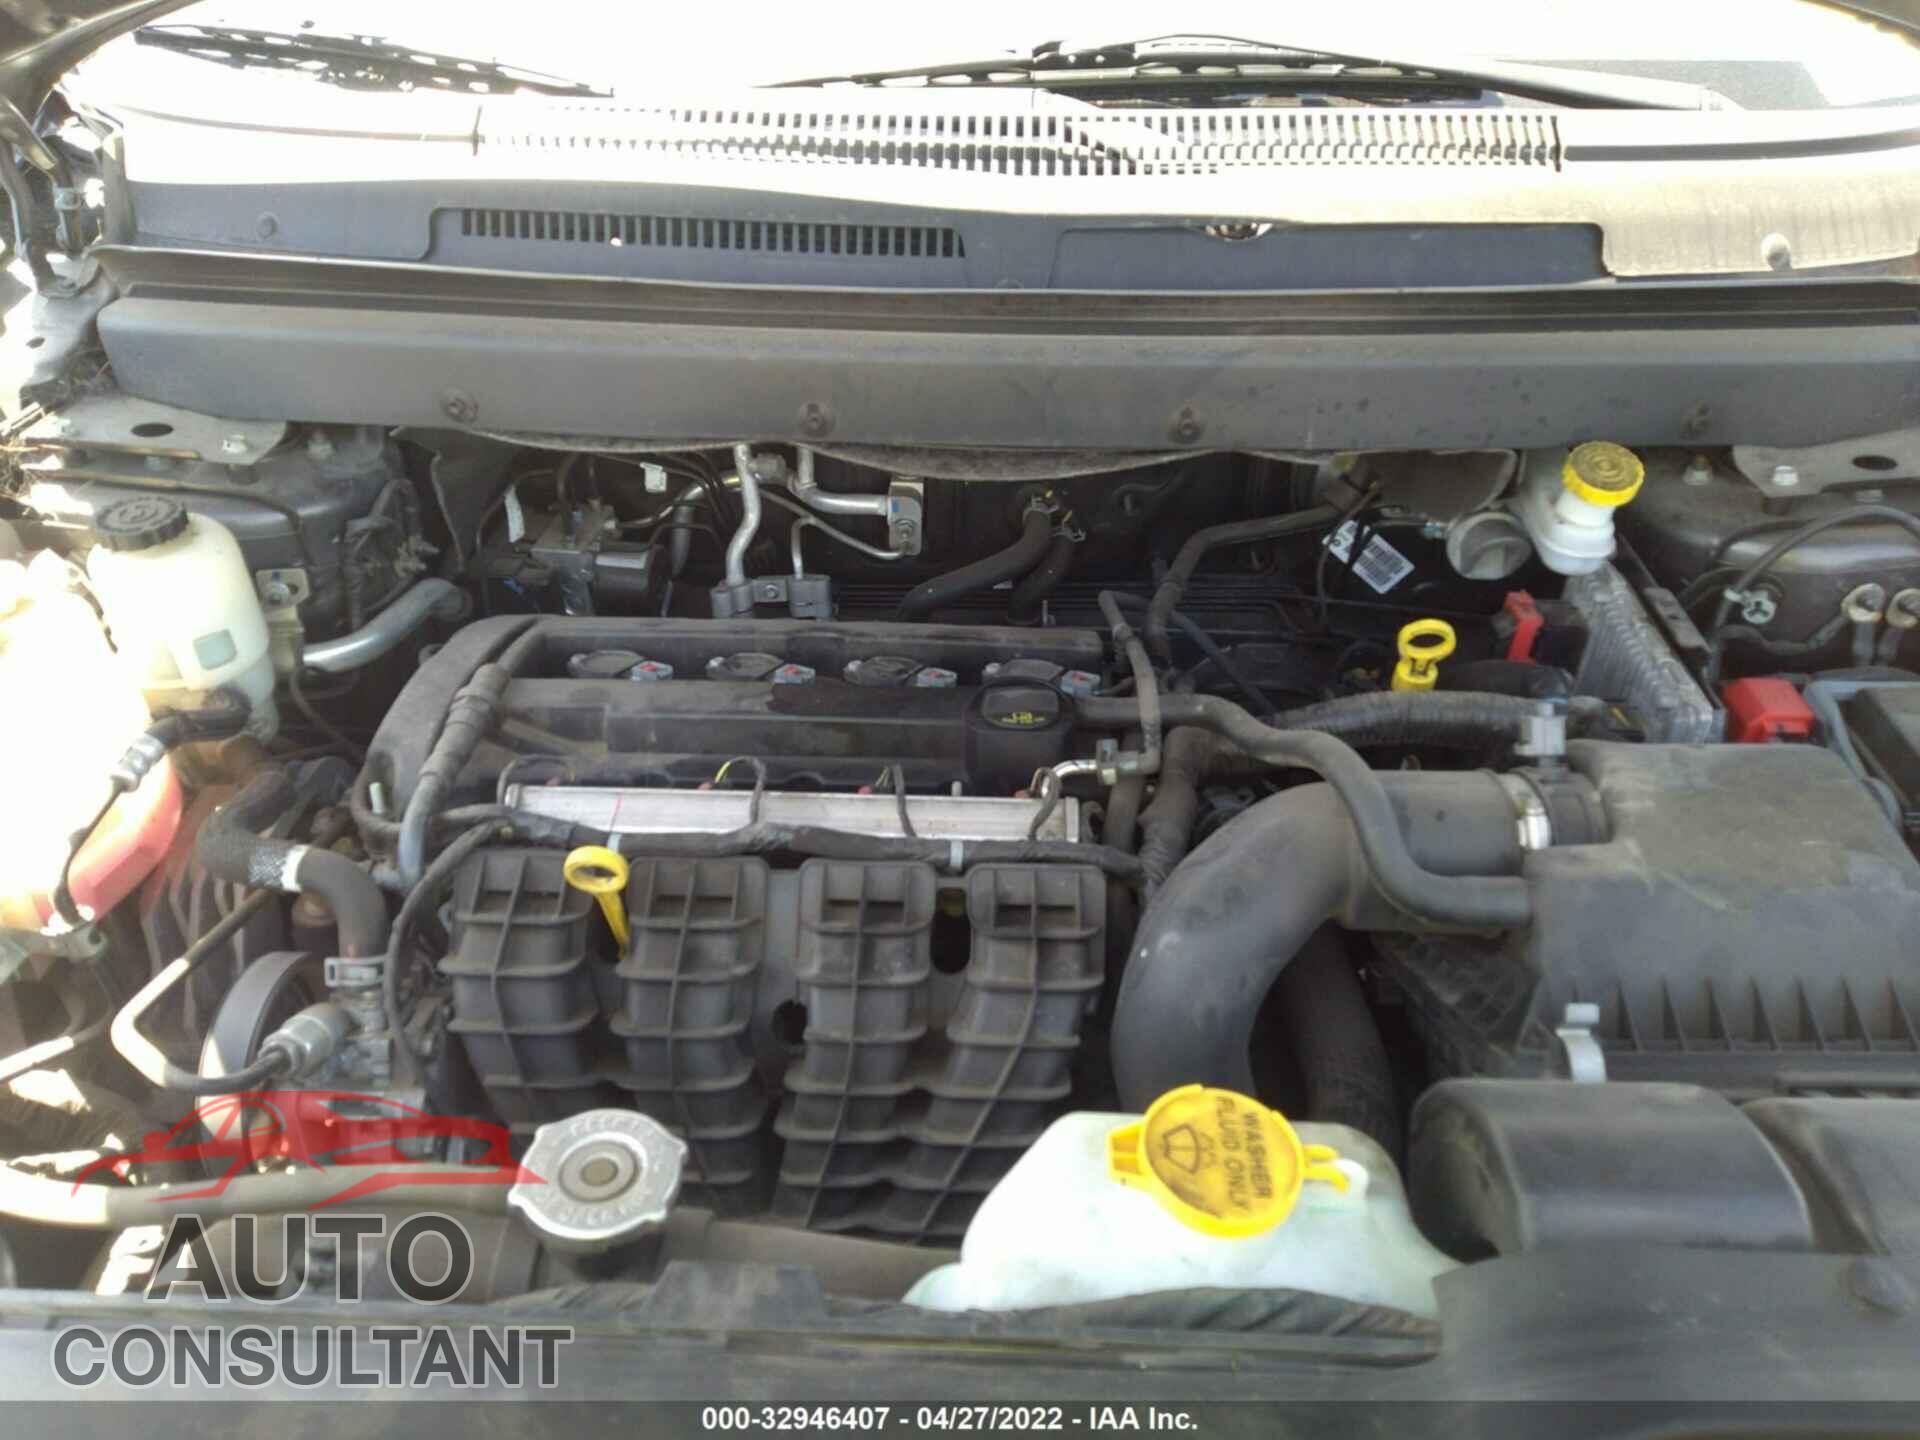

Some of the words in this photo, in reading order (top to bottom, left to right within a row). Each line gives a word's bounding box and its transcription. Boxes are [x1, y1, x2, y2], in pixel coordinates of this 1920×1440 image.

[1217, 1097, 1240, 1151] FLUID
[1244, 1113, 1272, 1198] WASHER
[1225, 1158, 1250, 1210] ONLY
